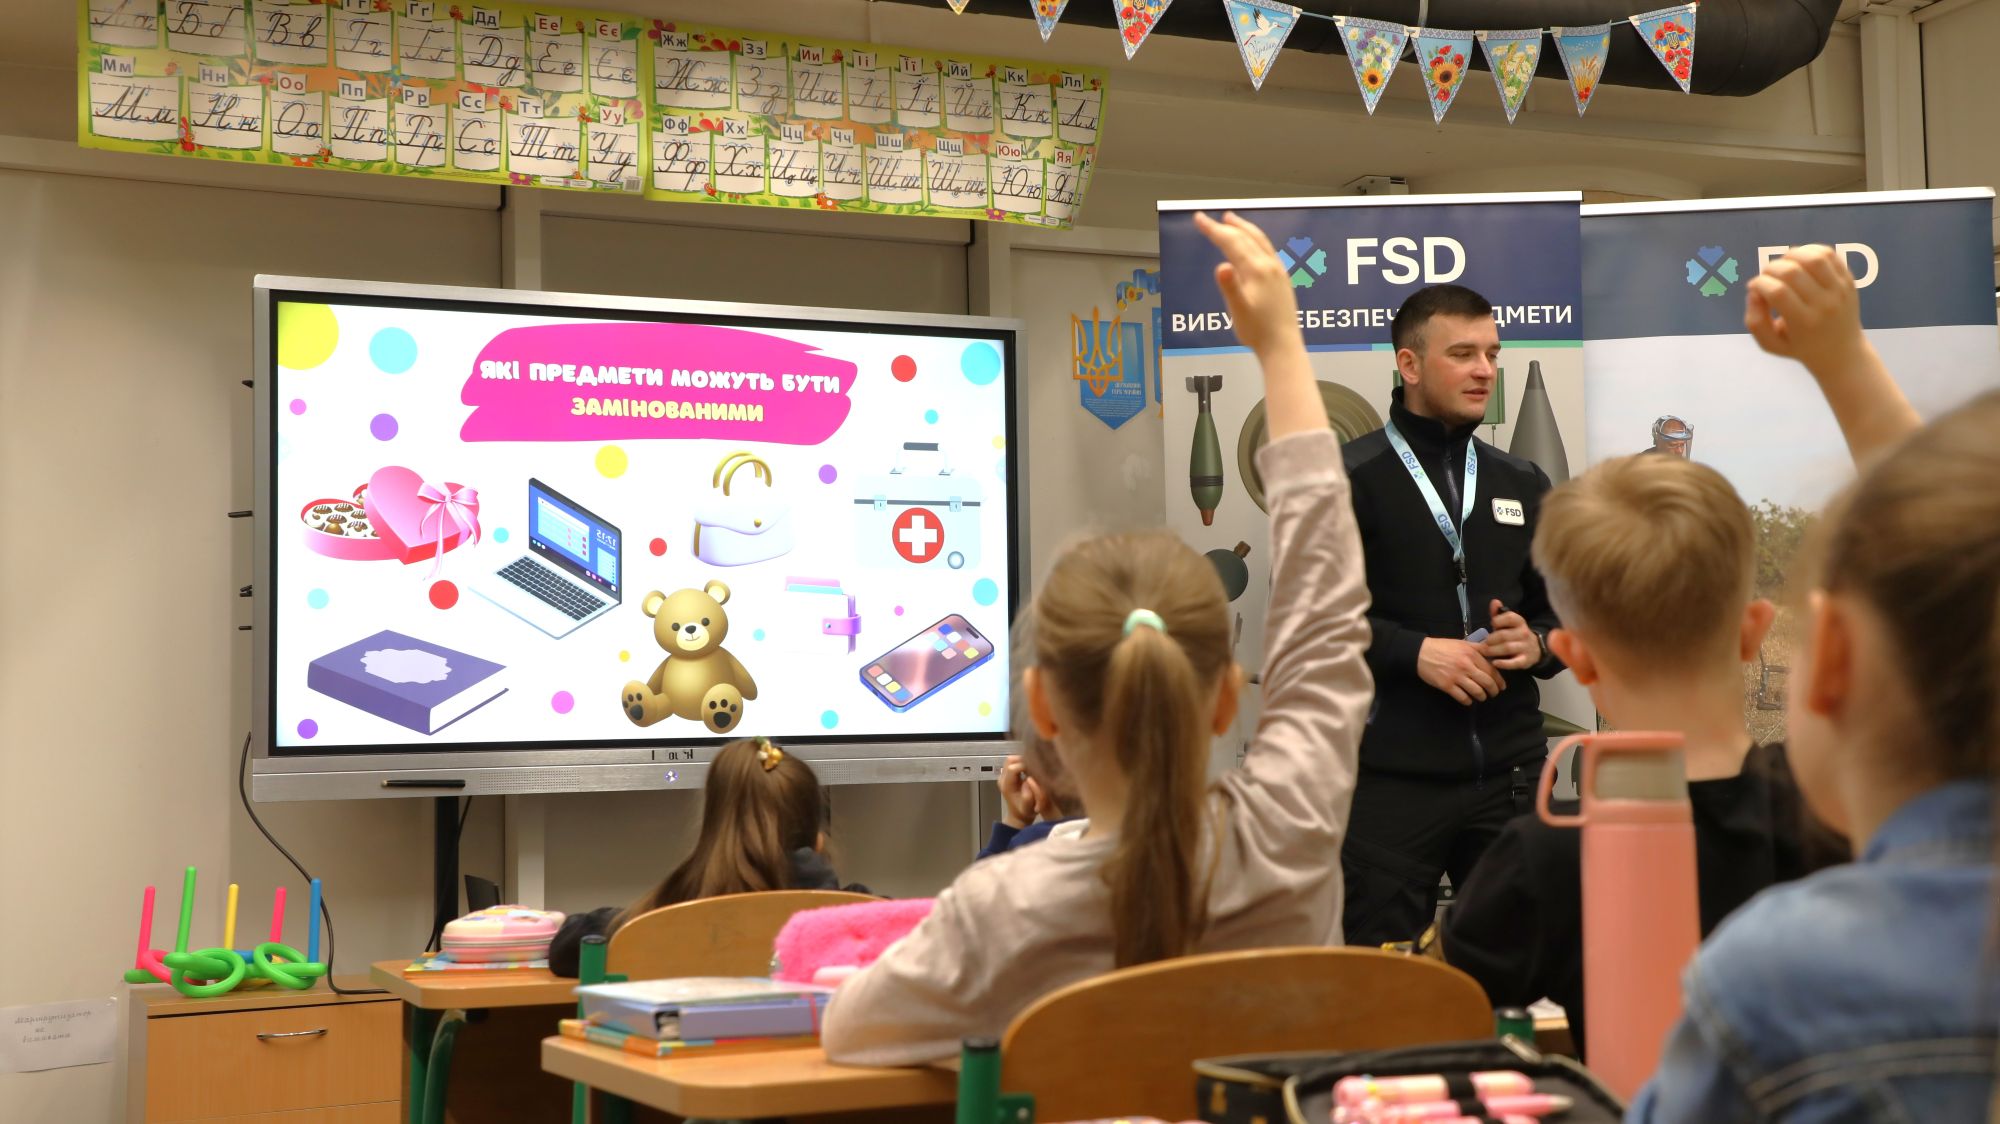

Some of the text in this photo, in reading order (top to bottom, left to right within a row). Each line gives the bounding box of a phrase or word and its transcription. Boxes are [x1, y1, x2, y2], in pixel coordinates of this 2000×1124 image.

[267, 12, 322, 47] Вв
[475, 12, 496, 27] Дд
[539, 19, 559, 31] Ее
[599, 25, 618, 37] Єє
[663, 34, 686, 47] Жж
[746, 43, 763, 55] Зз
[802, 50, 820, 62] Ии
[951, 63, 968, 76] Йй
[1008, 71, 1024, 82] Кк
[1064, 76, 1080, 87] Лл
[103, 59, 622, 124] Мм Нн Оо Пп Рр Сс Тт Уу
[665, 119, 687, 133] Фф
[725, 121, 744, 134] Хх
[783, 127, 802, 141] Цц
[834, 131, 851, 143] Чч
[878, 136, 901, 147] Шш
[939, 139, 961, 153] Щщ
[999, 146, 1020, 157] Юю
[1057, 152, 1071, 163] Яя
[1346, 236, 1466, 285] FSD
[1758, 242, 1879, 289] FD
[480, 360, 840, 394] ЯКІ ПРЕДМЕТИ МОЖУТЬ БУТИ
[571, 397, 763, 422] ЗАМІНОВАНИМИ
[1402, 451, 1419, 470] FSD
[1467, 456, 1476, 476] FSD
[1438, 513, 1453, 536] FSD
[1505, 509, 1521, 517] FSD
